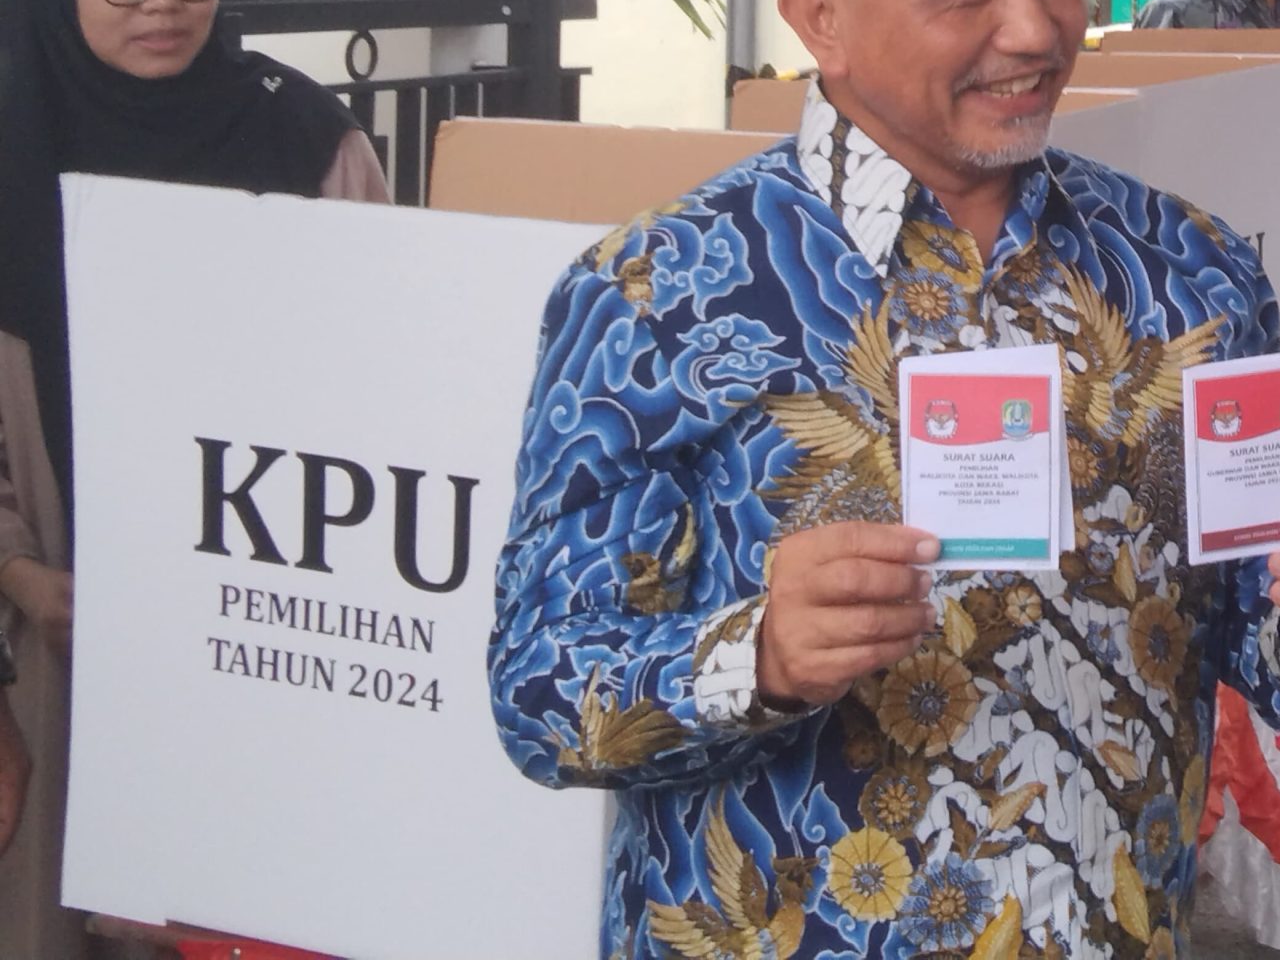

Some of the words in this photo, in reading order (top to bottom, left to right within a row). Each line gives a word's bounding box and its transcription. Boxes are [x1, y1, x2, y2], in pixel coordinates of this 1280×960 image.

[943, 453, 976, 462] SURAT
[979, 453, 1015, 462] SUARA
[1229, 444, 1262, 458] SURAT
[193, 435, 480, 594] KPU
[218, 583, 436, 654] PEMILIHAN
[207, 637, 337, 692] TAHUN
[347, 663, 444, 713] 2024
